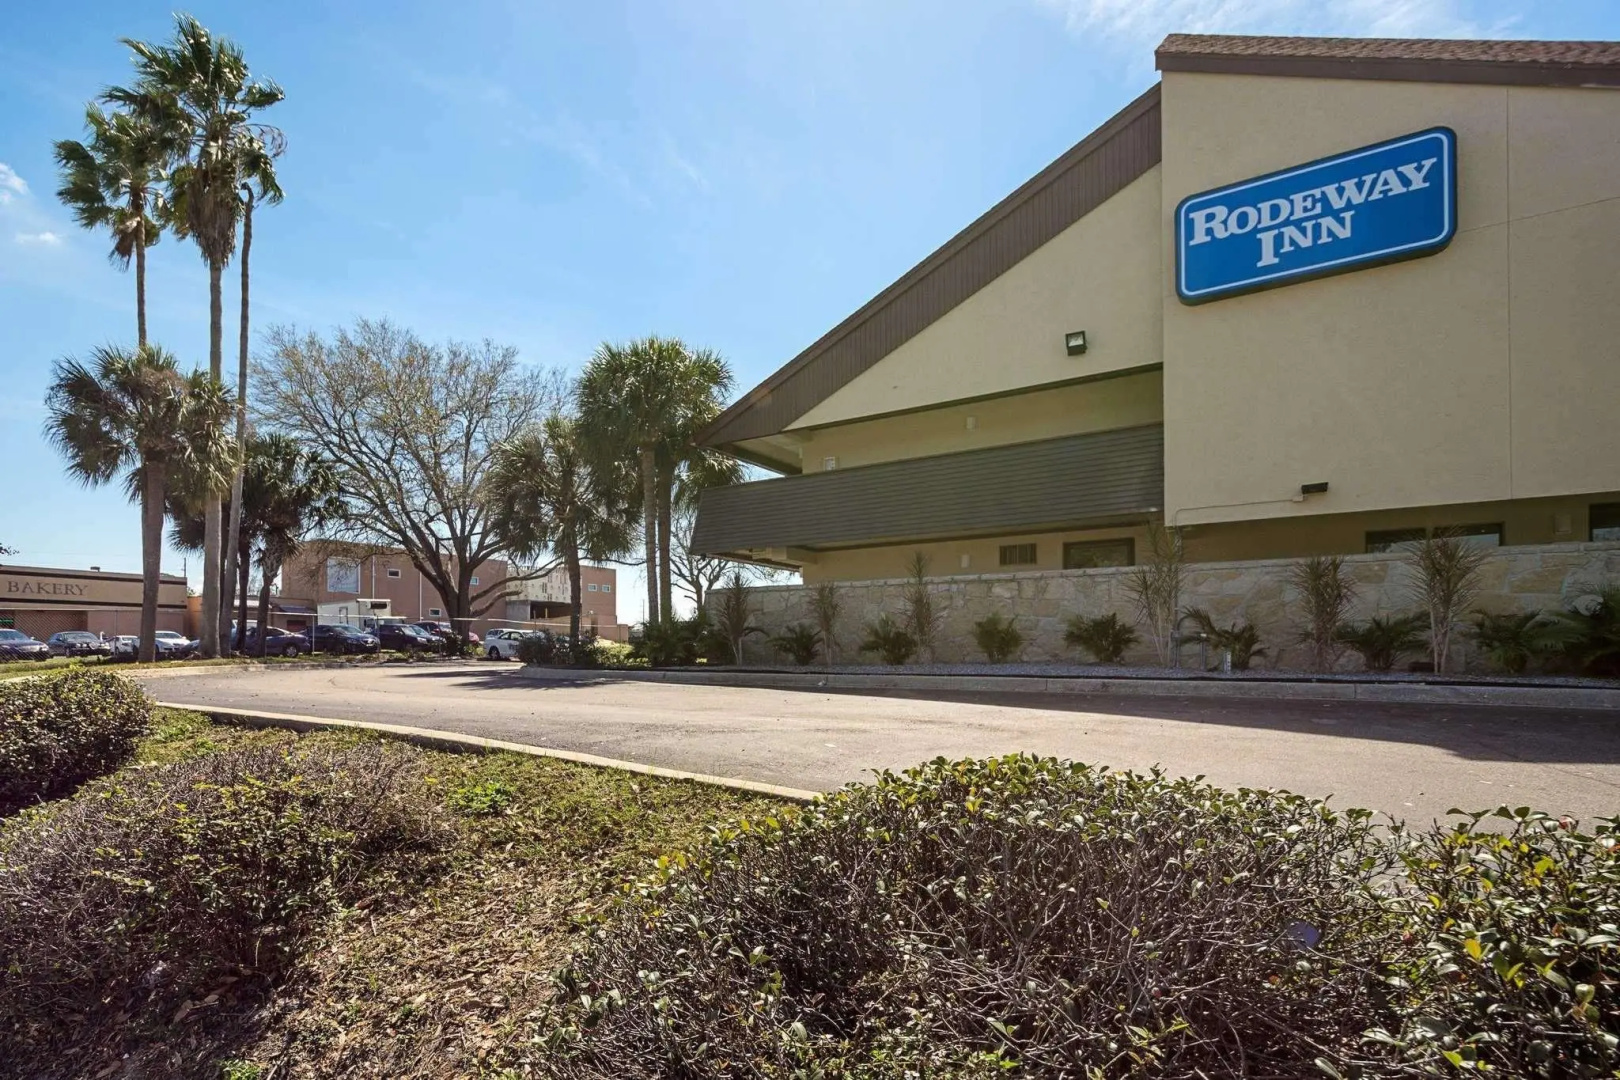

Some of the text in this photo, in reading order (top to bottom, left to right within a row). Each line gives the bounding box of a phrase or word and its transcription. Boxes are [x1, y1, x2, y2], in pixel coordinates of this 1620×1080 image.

[1189, 157, 1437, 246] RODEWAY
[1256, 210, 1355, 268] INN
[7, 581, 88, 595] BAKERY
